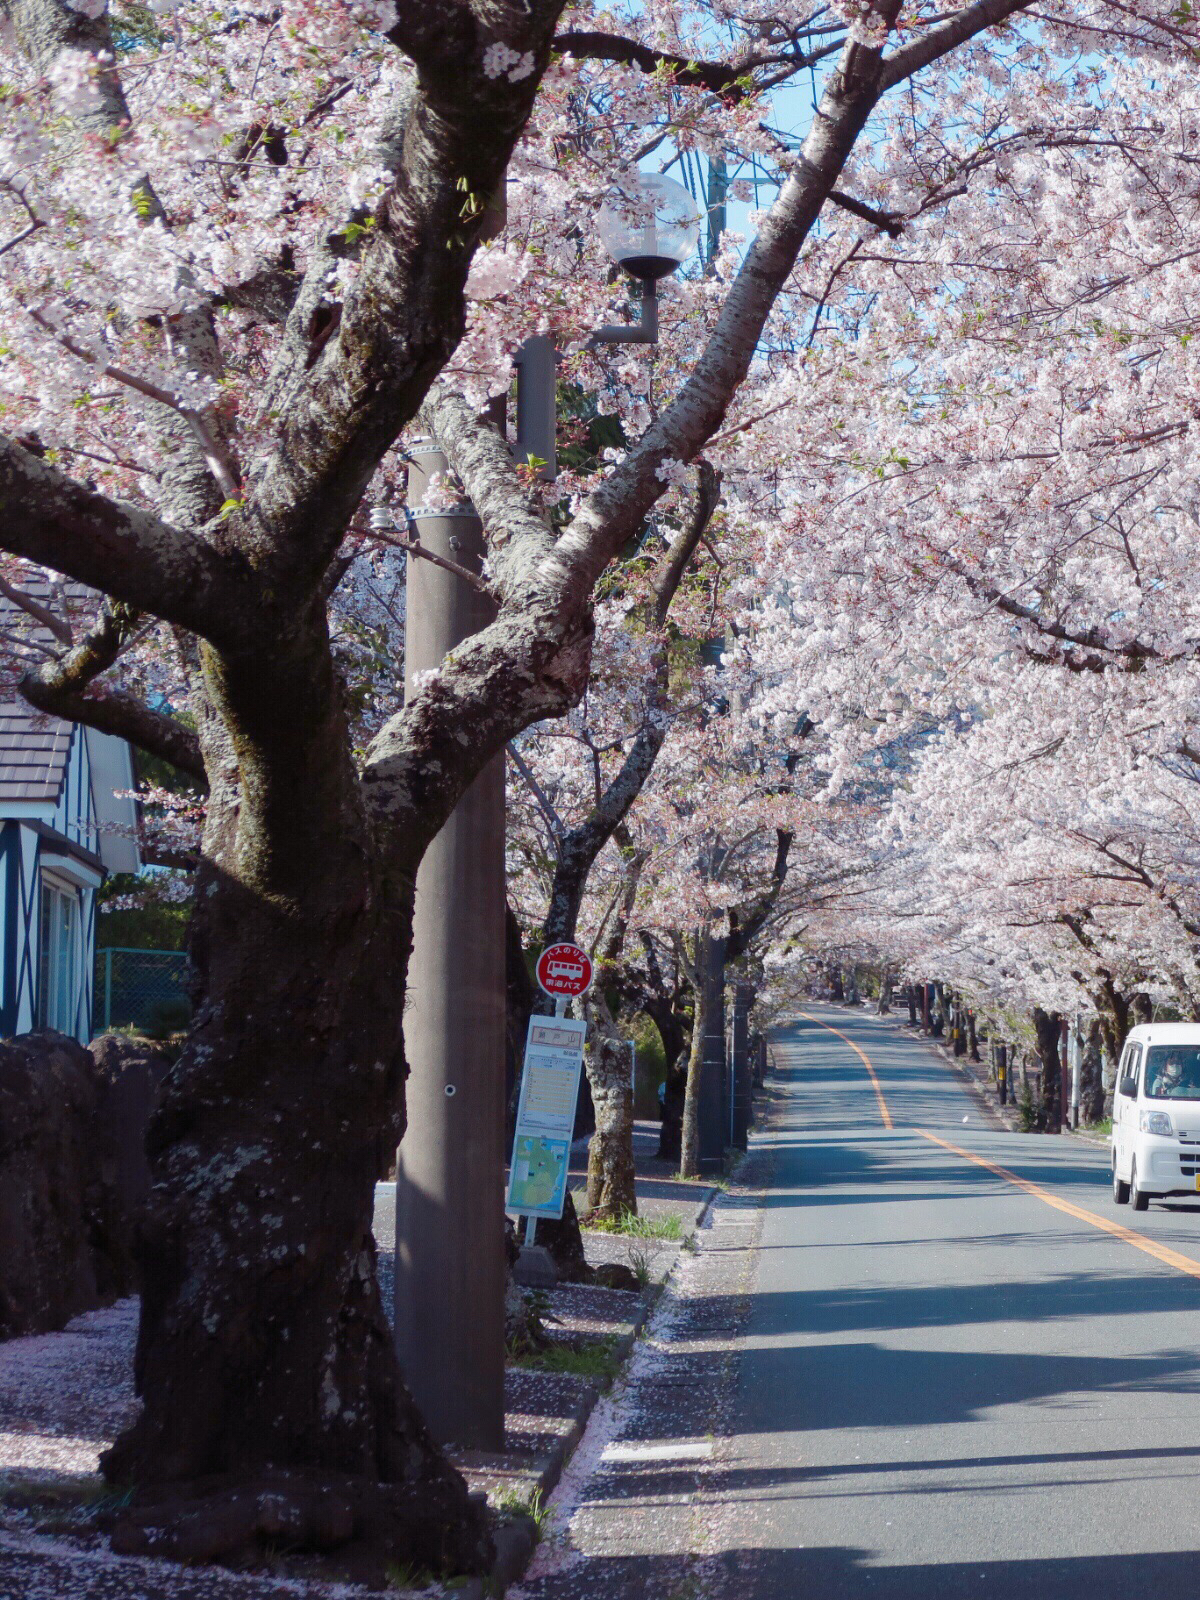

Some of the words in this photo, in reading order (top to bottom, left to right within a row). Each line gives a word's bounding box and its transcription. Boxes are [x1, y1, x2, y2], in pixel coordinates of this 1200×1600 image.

[547, 947, 587, 963] バスのりば
